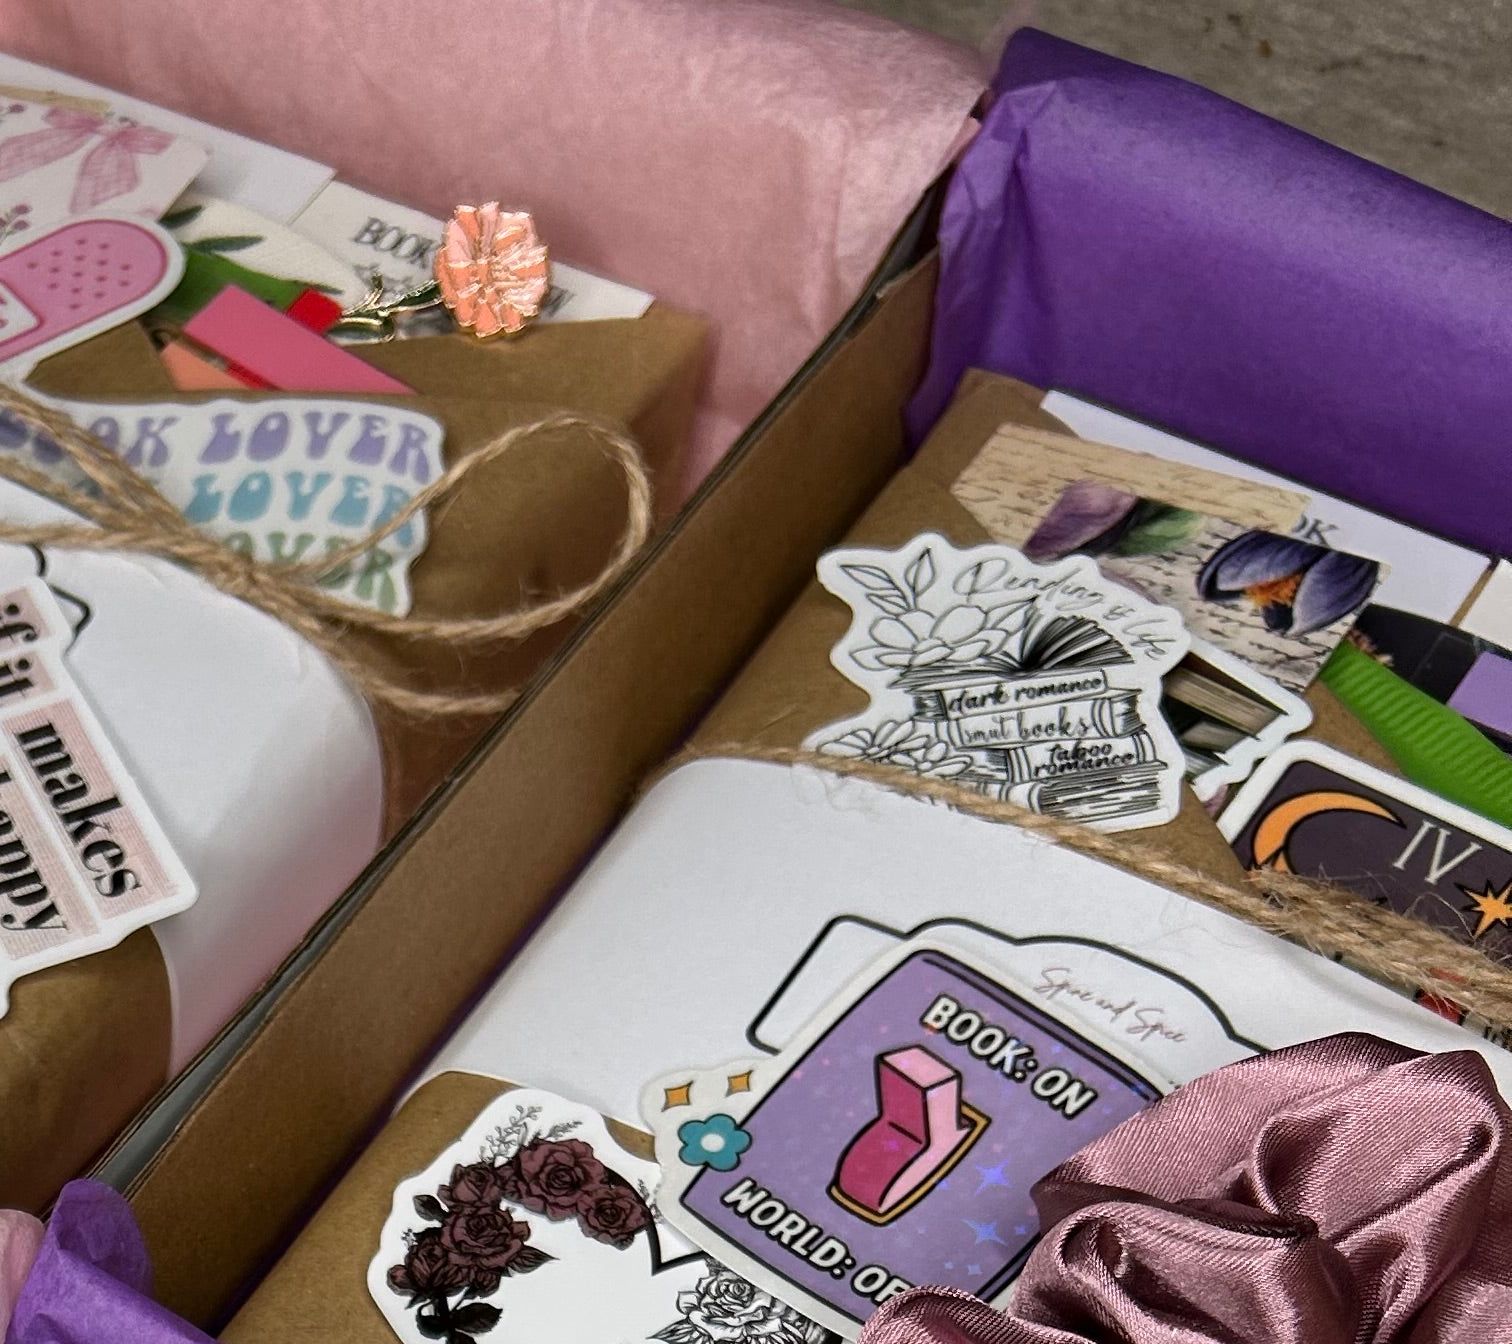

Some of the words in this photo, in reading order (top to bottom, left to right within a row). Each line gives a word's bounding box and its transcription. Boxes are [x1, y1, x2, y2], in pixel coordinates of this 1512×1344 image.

[198, 411, 437, 484] LOVER
[185, 471, 416, 547] LOVER
[948, 681, 1007, 714] dark
[1014, 676, 1103, 700] romance
[964, 716, 1010, 744] smut
[1016, 706, 1089, 741] books
[1034, 752, 1135, 777] romance
[13, 720, 142, 900] makes
[1393, 820, 1482, 885] IV
[921, 994, 1038, 1082] BOOK:
[1031, 1067, 1097, 1118] ON
[721, 1177, 855, 1278] WORLD:
